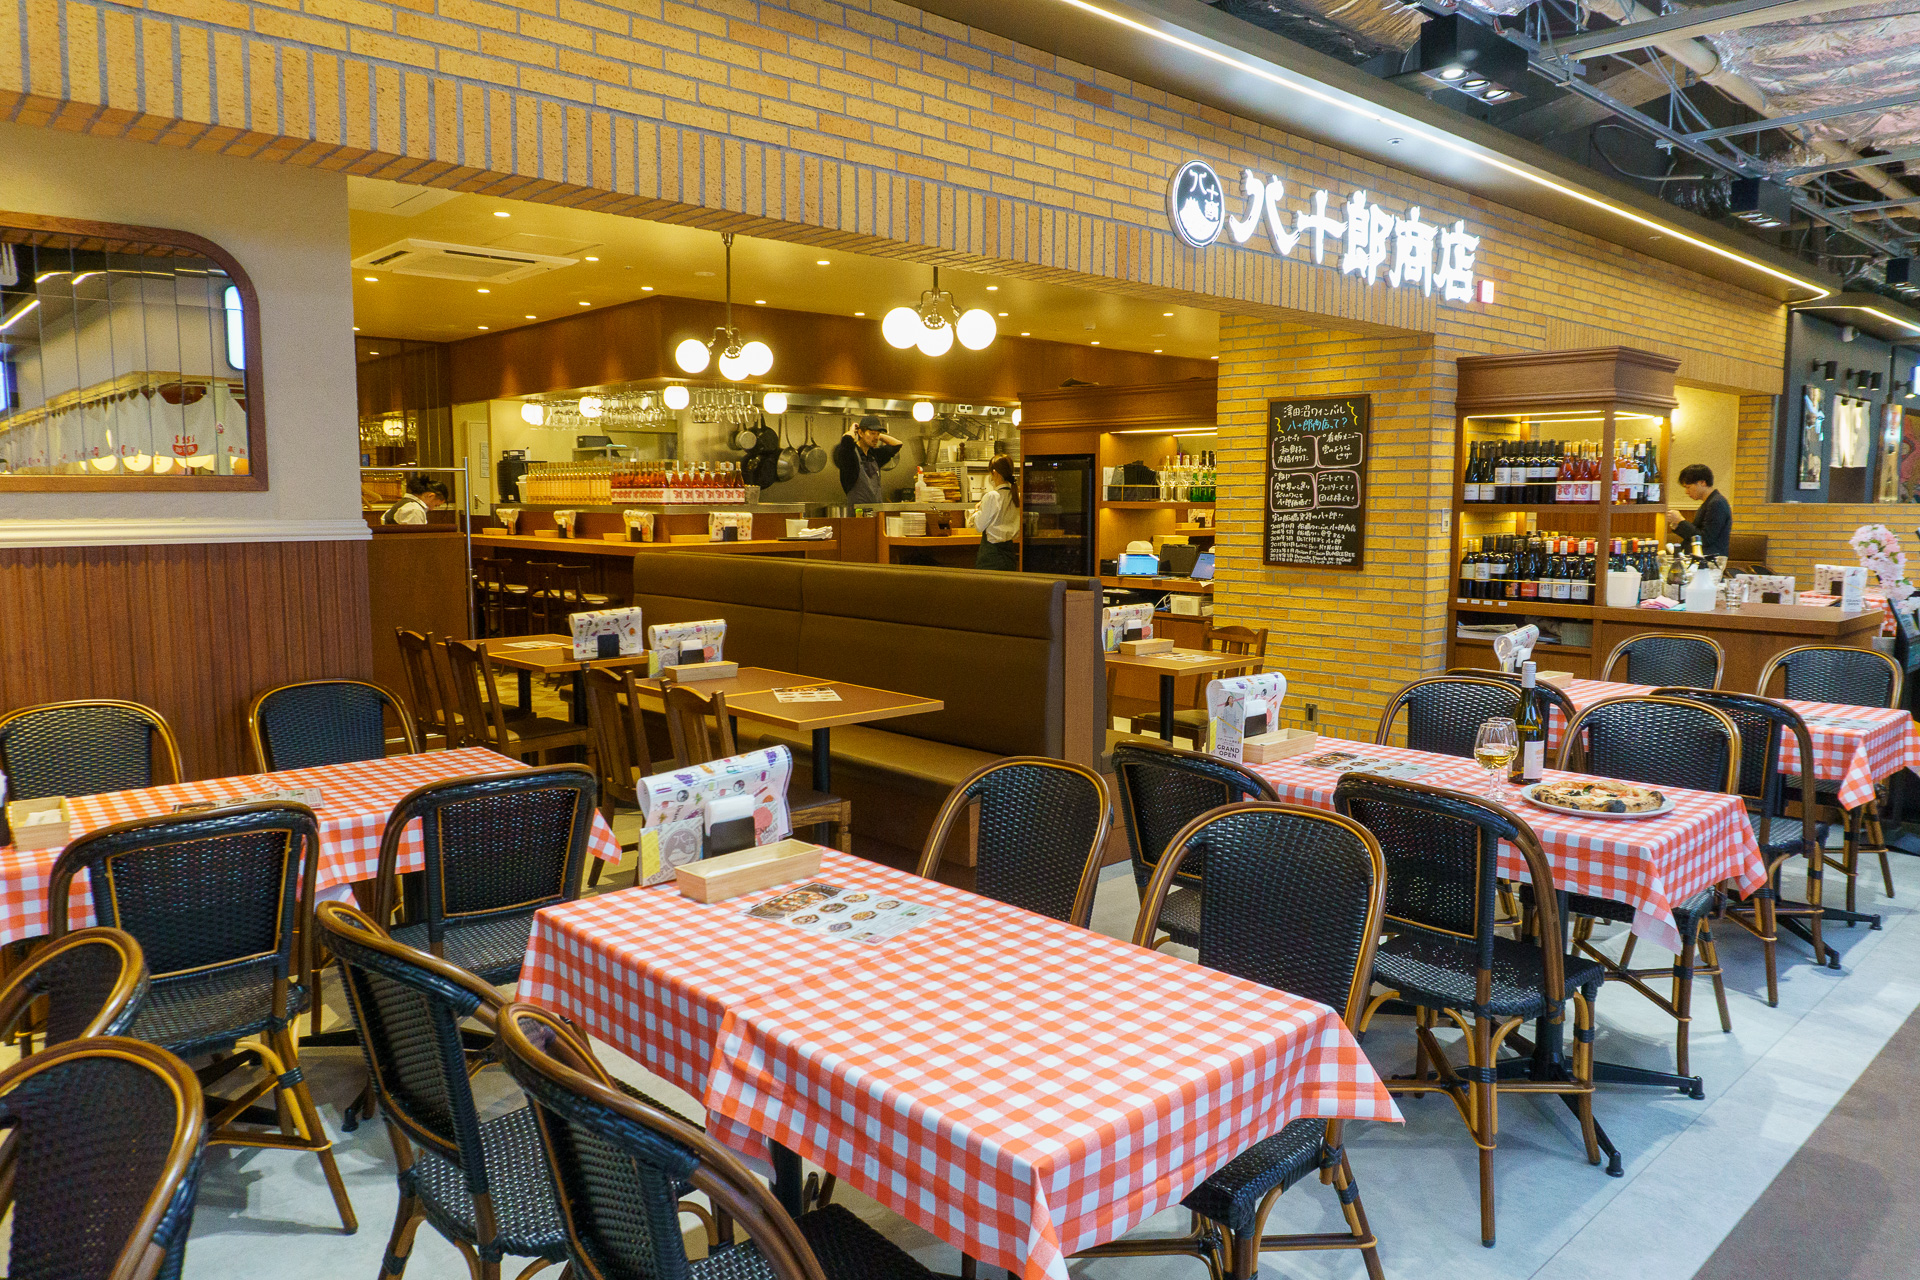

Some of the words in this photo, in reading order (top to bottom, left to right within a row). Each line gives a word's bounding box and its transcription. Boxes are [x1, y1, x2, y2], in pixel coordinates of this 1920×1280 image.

[1226, 168, 1480, 303] 八十郎商店
[1217, 744, 1240, 753] GRAND
